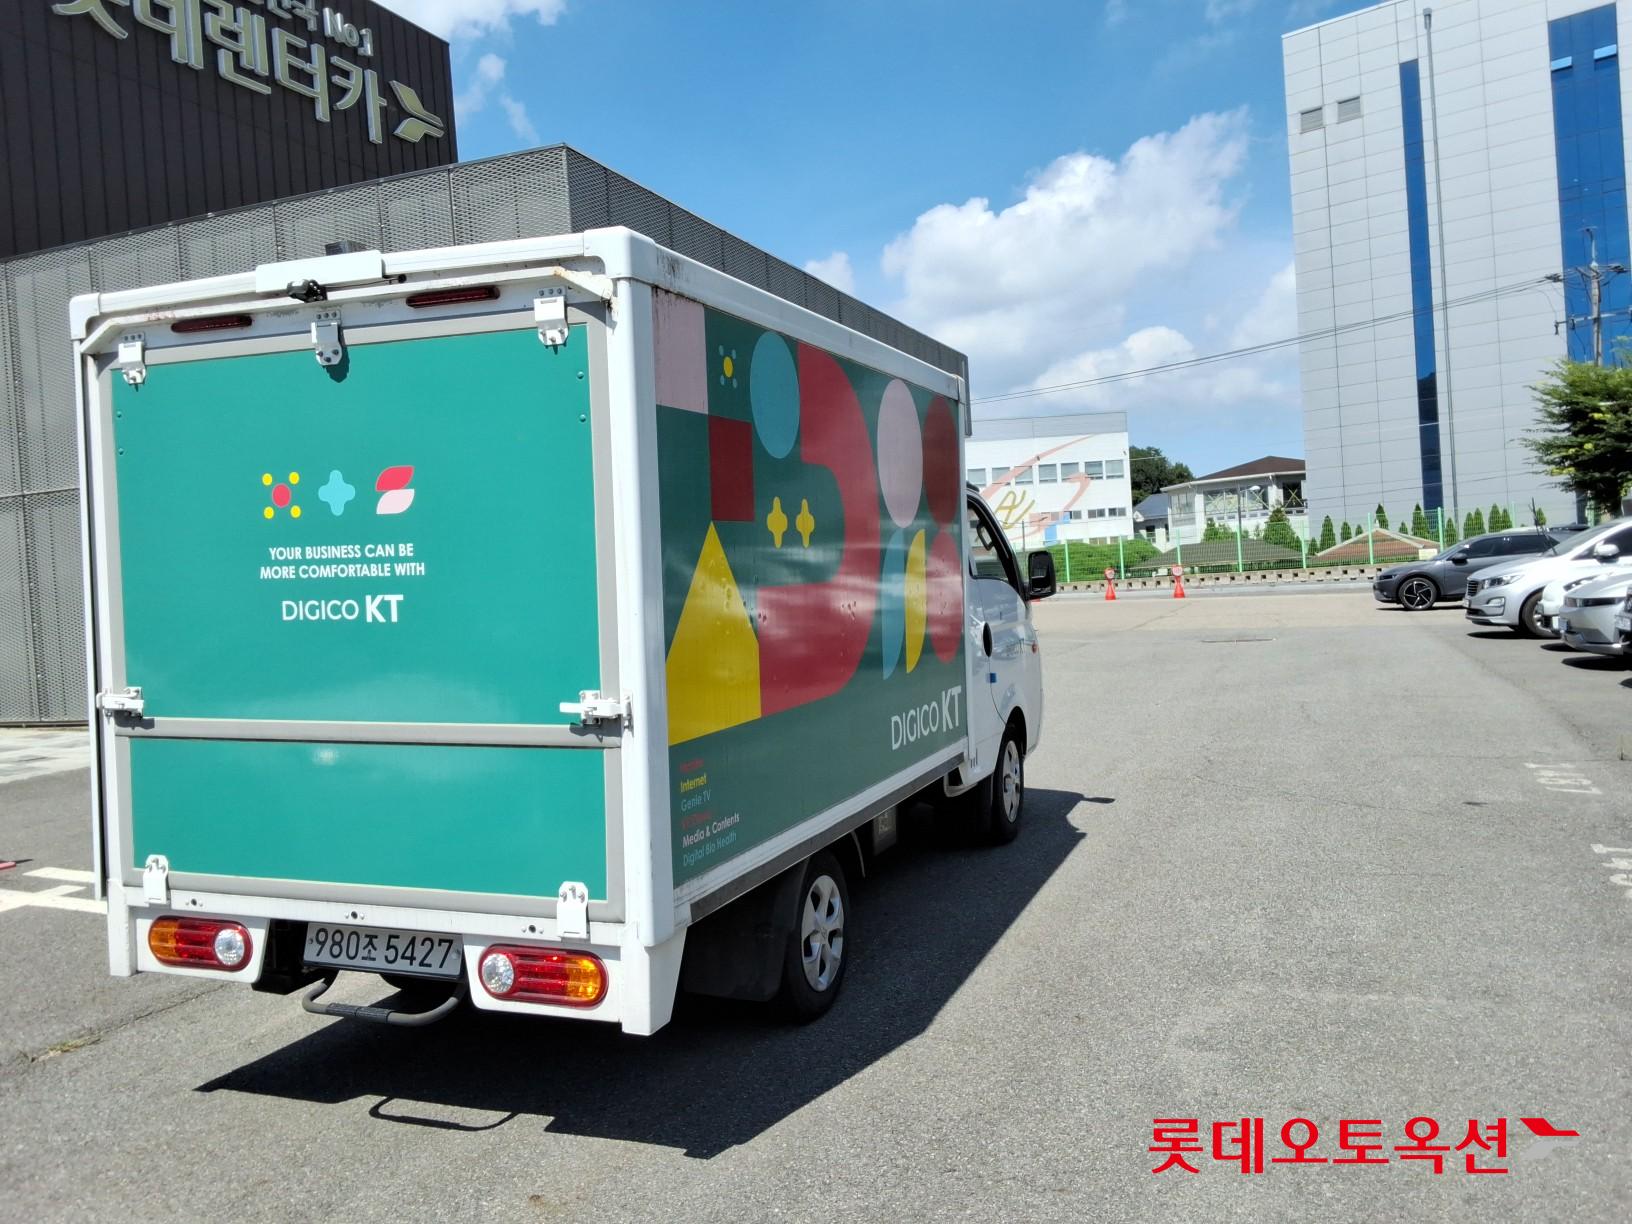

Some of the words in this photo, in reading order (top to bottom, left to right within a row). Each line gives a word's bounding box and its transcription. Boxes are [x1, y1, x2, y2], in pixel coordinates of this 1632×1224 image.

[269, 547, 302, 560] YOUR
[306, 545, 361, 559] BUSINESS
[365, 544, 395, 558] CAN
[399, 543, 414, 557] BE
[260, 565, 296, 579] MORE
[299, 563, 391, 578] COMFORTABLE
[394, 562, 425, 576] WITH
[680, 773, 707, 792] Internet
[681, 794, 702, 811] Genie
[703, 789, 711, 802] TV
[682, 830, 704, 848] Media
[705, 826, 711, 838] &
[712, 812, 740, 833] Contents
[683, 847, 705, 866] Digital
[706, 843, 715, 855] Bio
[717, 832, 737, 848] Health
[384, 934, 454, 969] 5427
